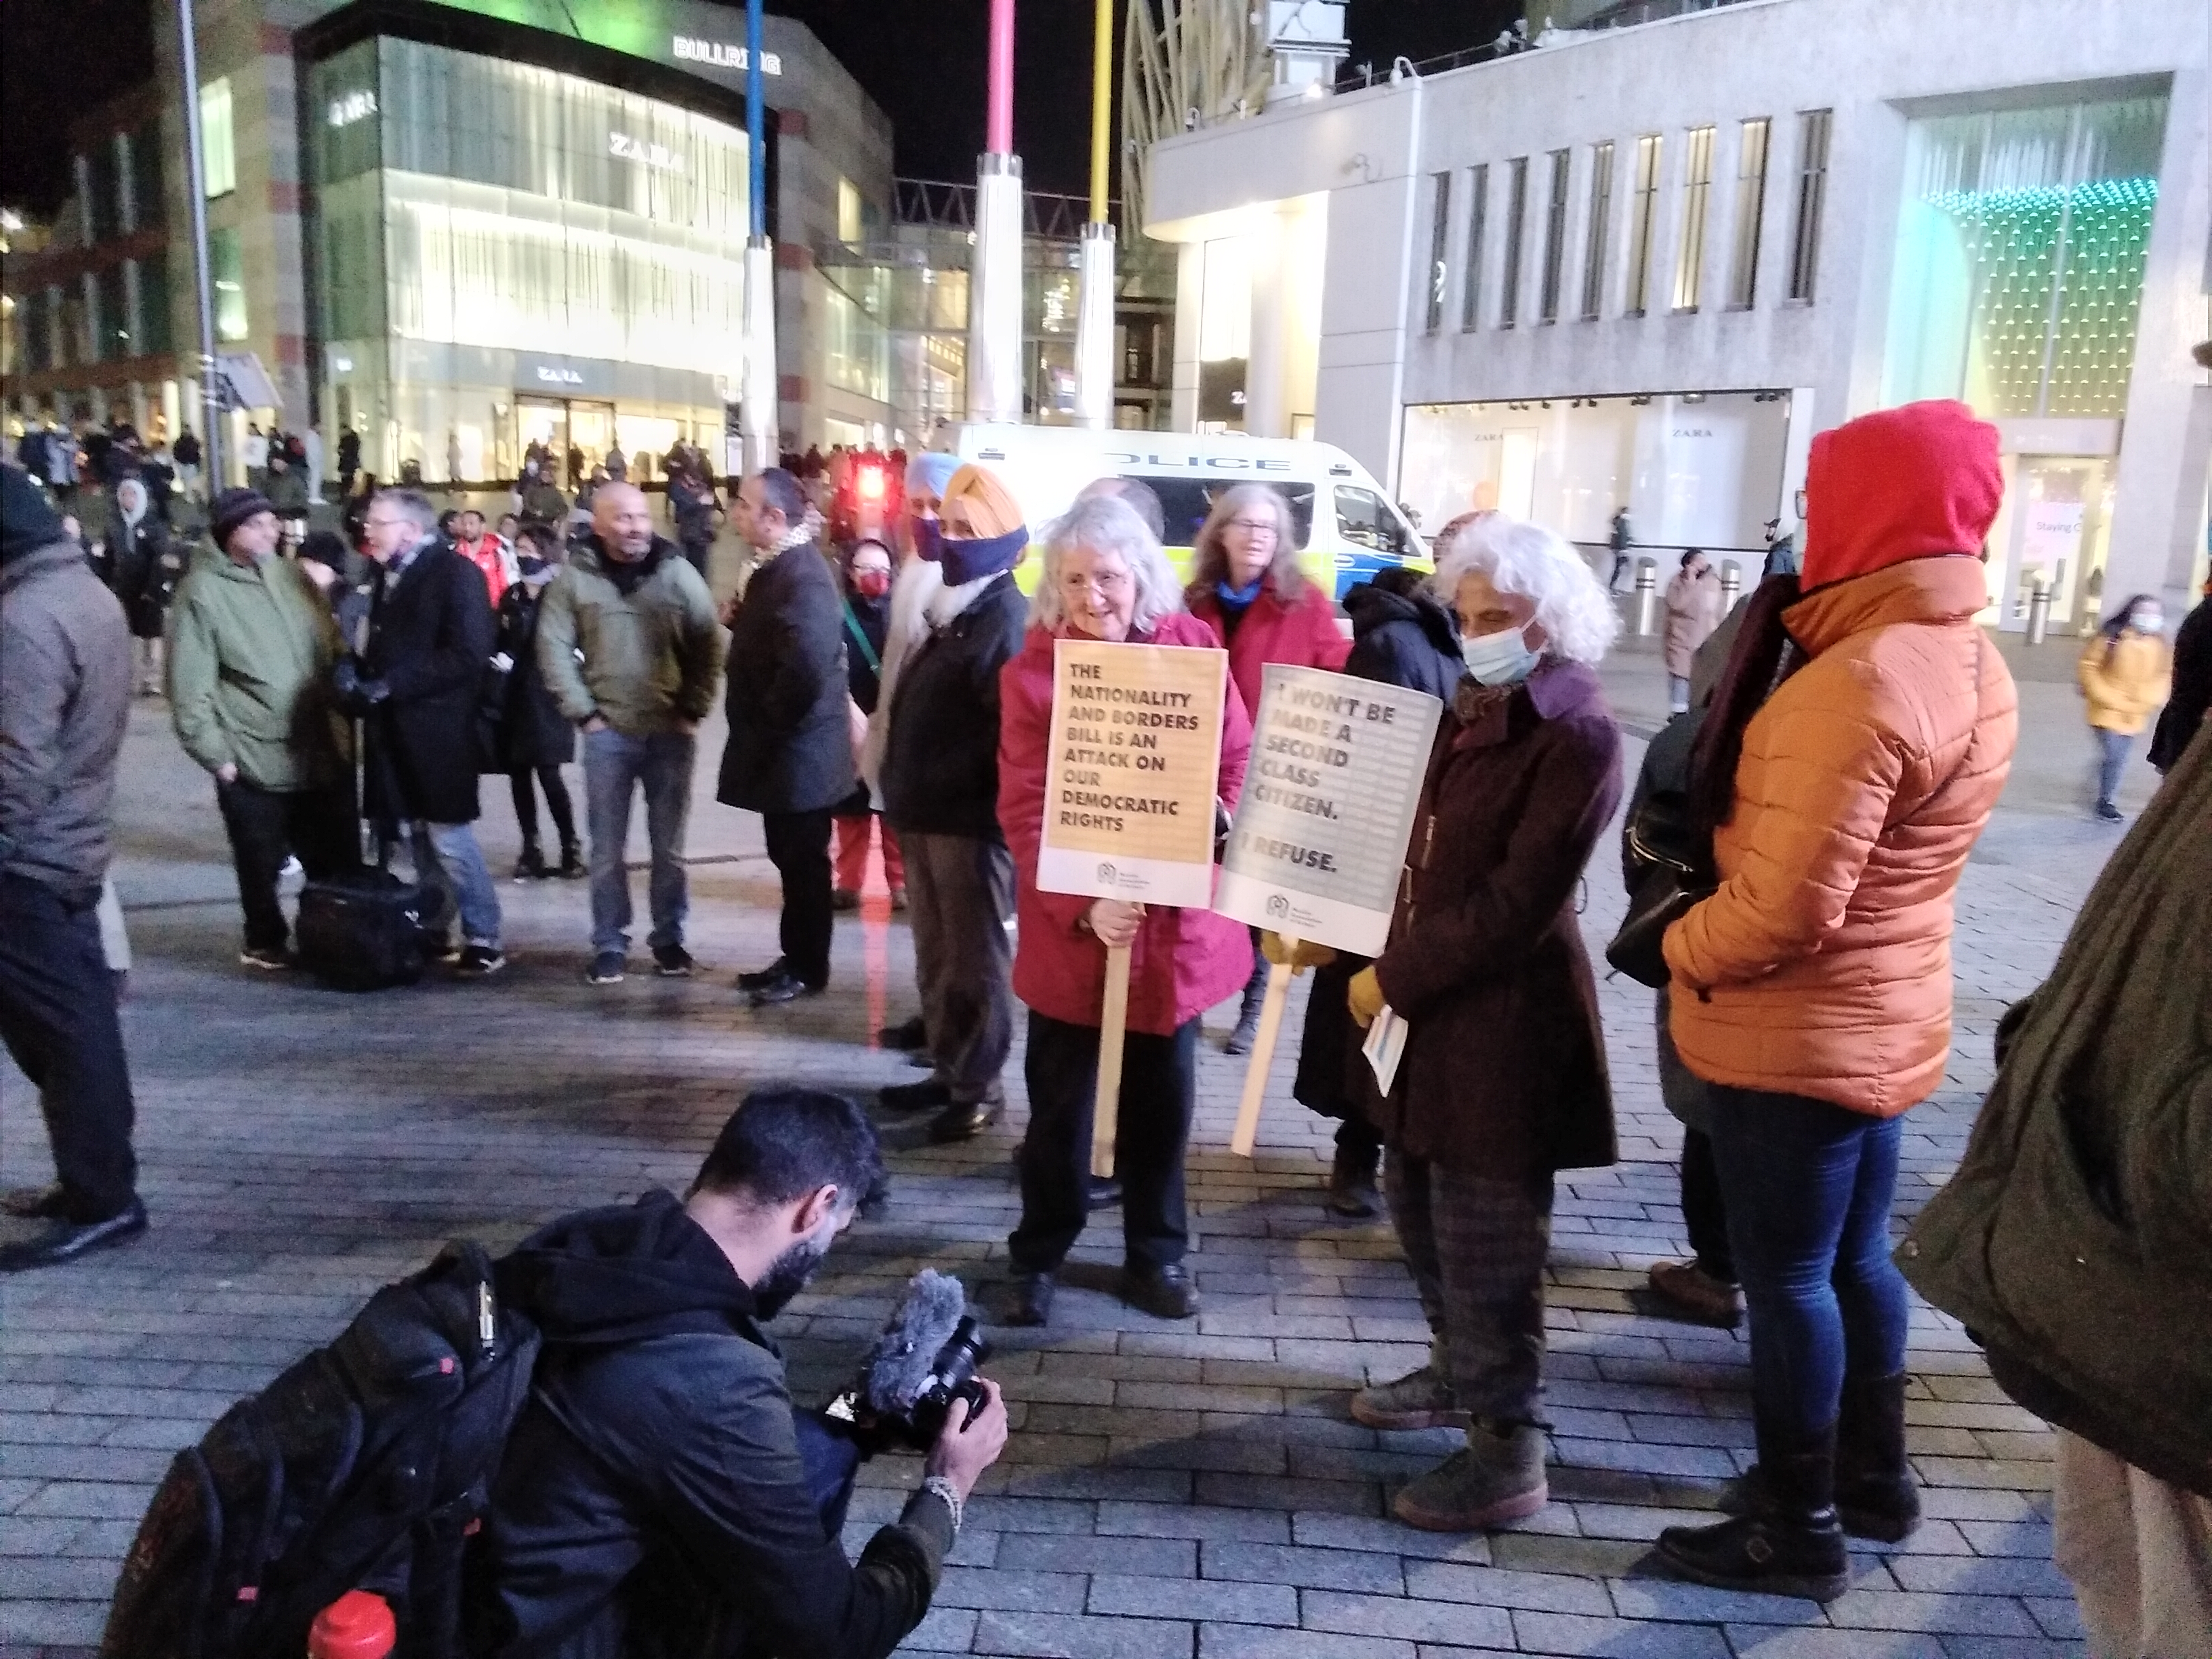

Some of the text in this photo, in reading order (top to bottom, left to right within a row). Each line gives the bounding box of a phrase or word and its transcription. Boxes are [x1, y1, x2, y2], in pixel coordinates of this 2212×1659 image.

[609, 131, 685, 173] ZARA
[1673, 429, 1713, 438] ZARA
[1103, 452, 1292, 472] OLICE
[2036, 521, 2071, 534] Staying
[1070, 663, 1101, 678] THE
[1070, 684, 1191, 708] NATIONALITY
[1278, 683, 1395, 724] I WON'T BE
[1069, 705, 1199, 730] AND BORDERS
[1273, 710, 1351, 742] MADE A
[1067, 727, 1157, 749] BILL IS AN
[1065, 749, 1165, 771] ATTACK ON
[1266, 735, 1347, 766] SECOND
[1063, 770, 1101, 786] OUR
[1262, 760, 1319, 787] CLASS
[1063, 790, 1179, 815] DEMOCRATIC
[1256, 785, 1337, 819] CITIZEN.
[1061, 811, 1124, 832] RIGHTS
[1242, 832, 1337, 872] I REFUSE.
